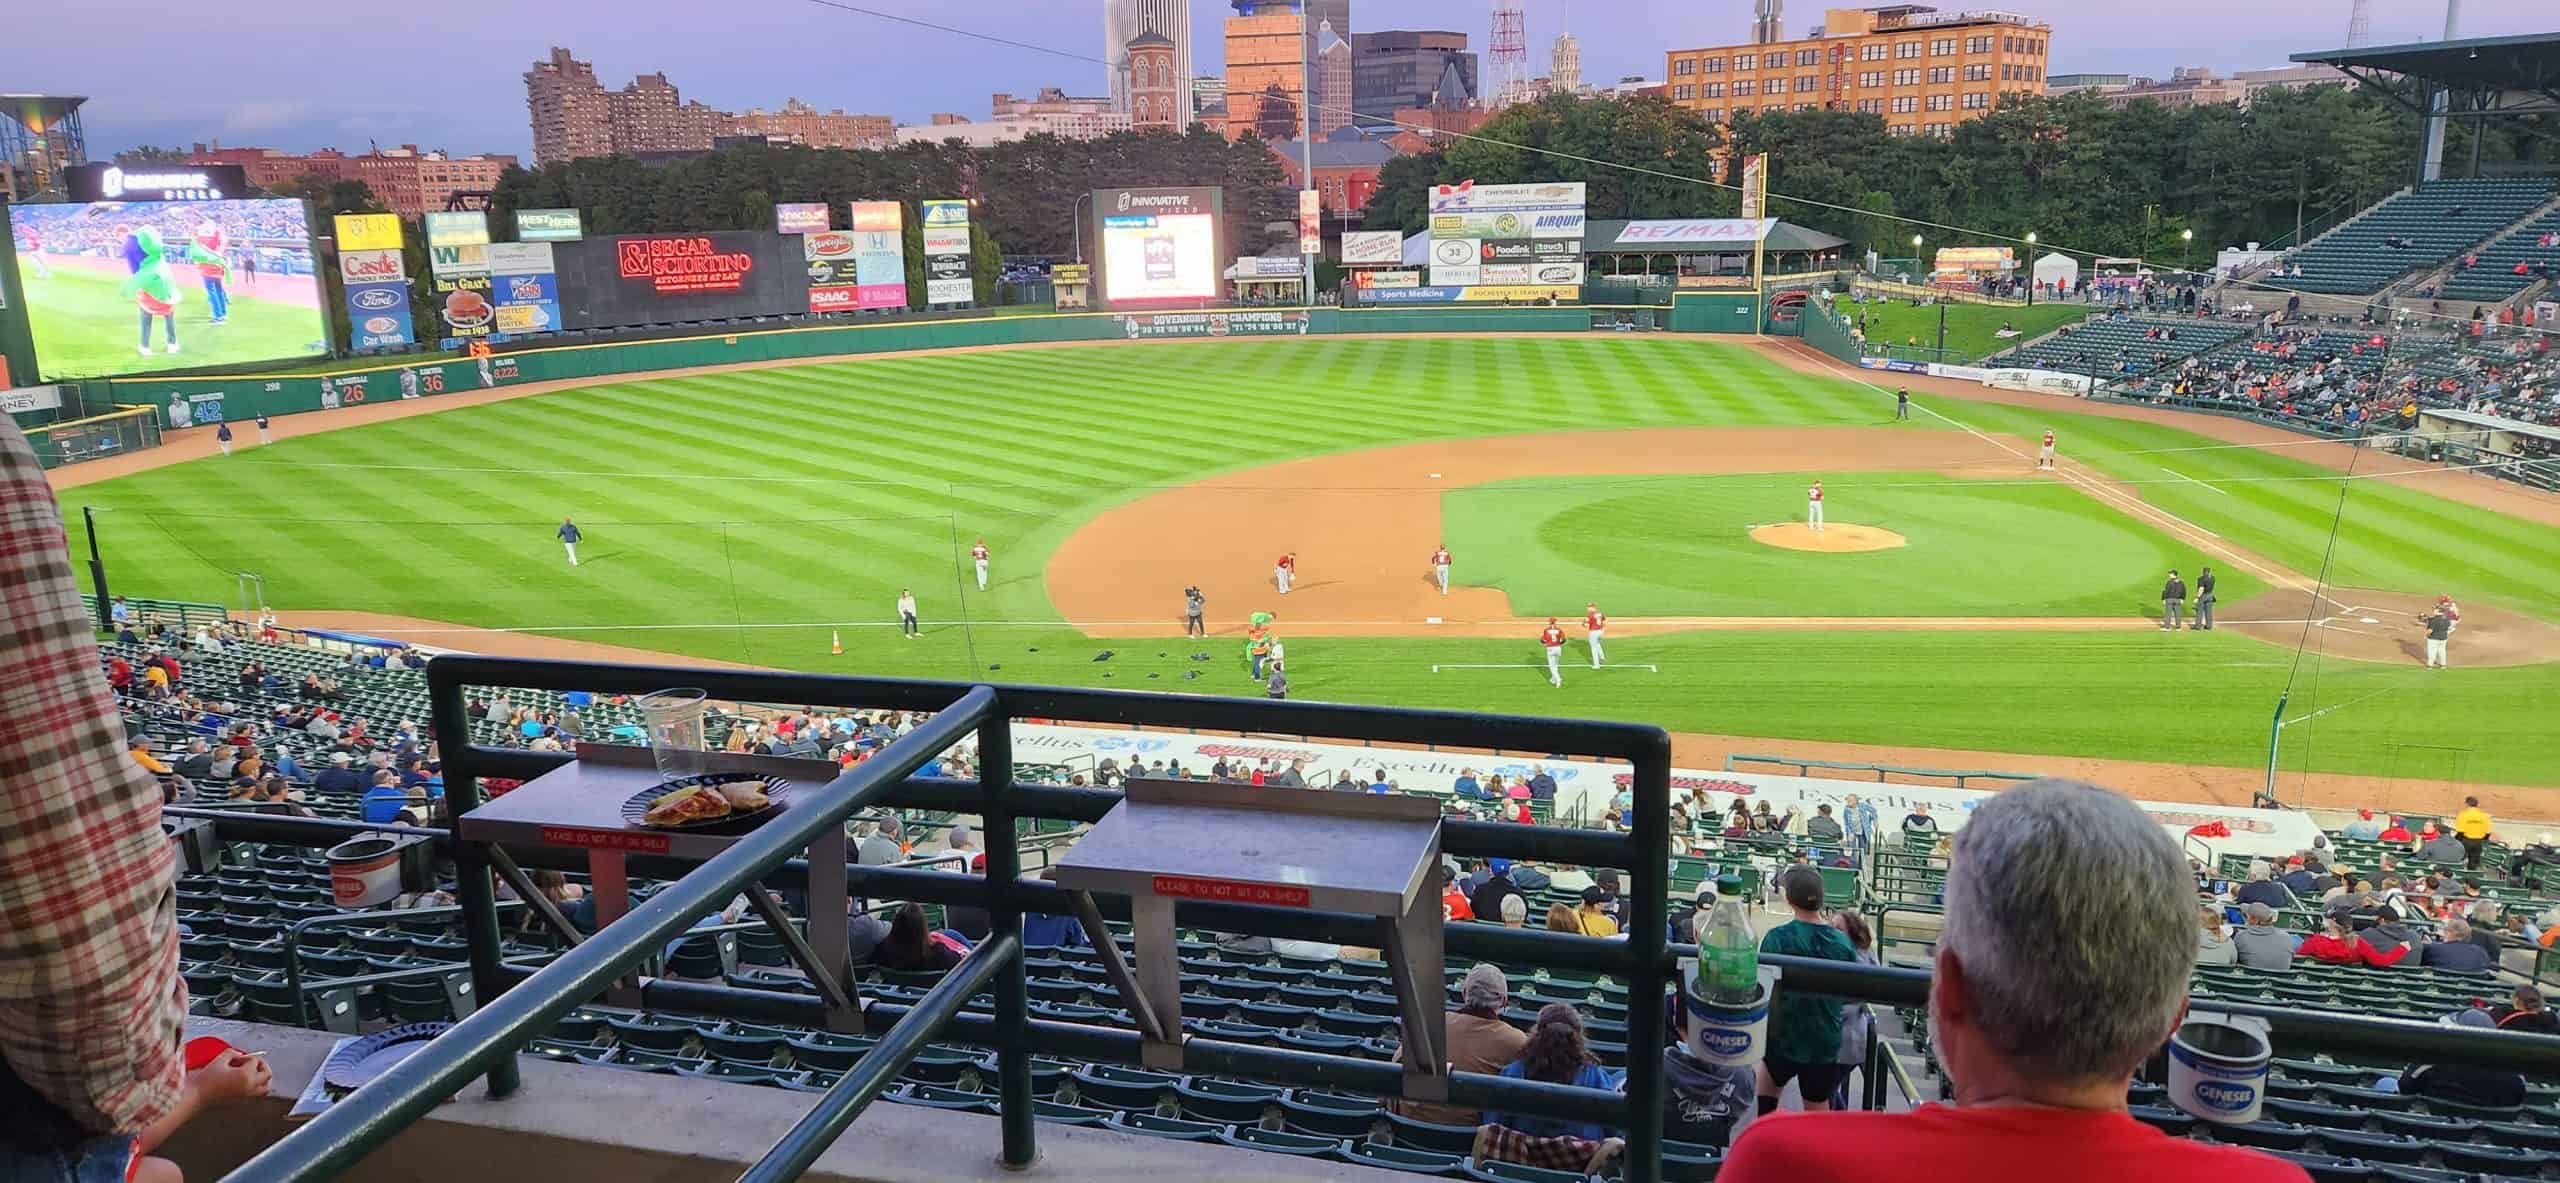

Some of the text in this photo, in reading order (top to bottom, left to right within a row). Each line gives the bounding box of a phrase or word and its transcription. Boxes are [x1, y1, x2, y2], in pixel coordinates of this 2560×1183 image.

[164, 189, 222, 200] FIELD
[1131, 195, 1189, 207] INNOVATIVE
[1536, 215, 1584, 228] AIRQUIP
[1623, 224, 1760, 239] RE/MAX
[624, 239, 713, 273] & SEGAR
[1496, 244, 1530, 254] Foodlink
[344, 253, 399, 275] Castle
[652, 254, 752, 274] SCIORTINO
[655, 272, 740, 283] ATTORNEYS AT LAW
[362, 291, 391, 306] Ford
[811, 291, 849, 302] ISAAC
[1381, 290, 1406, 299] Sports
[1408, 288, 1445, 297] Medicine
[1229, 312, 1282, 322] CHAMPIONS
[363, 333, 403, 345] Car Wash
[422, 375, 443, 392] 36
[343, 384, 364, 402] 26
[194, 401, 223, 422] 42
[544, 831, 574, 841] PLEASE
[577, 832, 590, 842] DO
[591, 834, 608, 844] NOT
[1156, 880, 1304, 902] PLEASE DO NOT SIT ON SHELF
[1703, 1032, 1749, 1048] GENESEE
[2199, 1085, 2251, 1102] GENESEE
